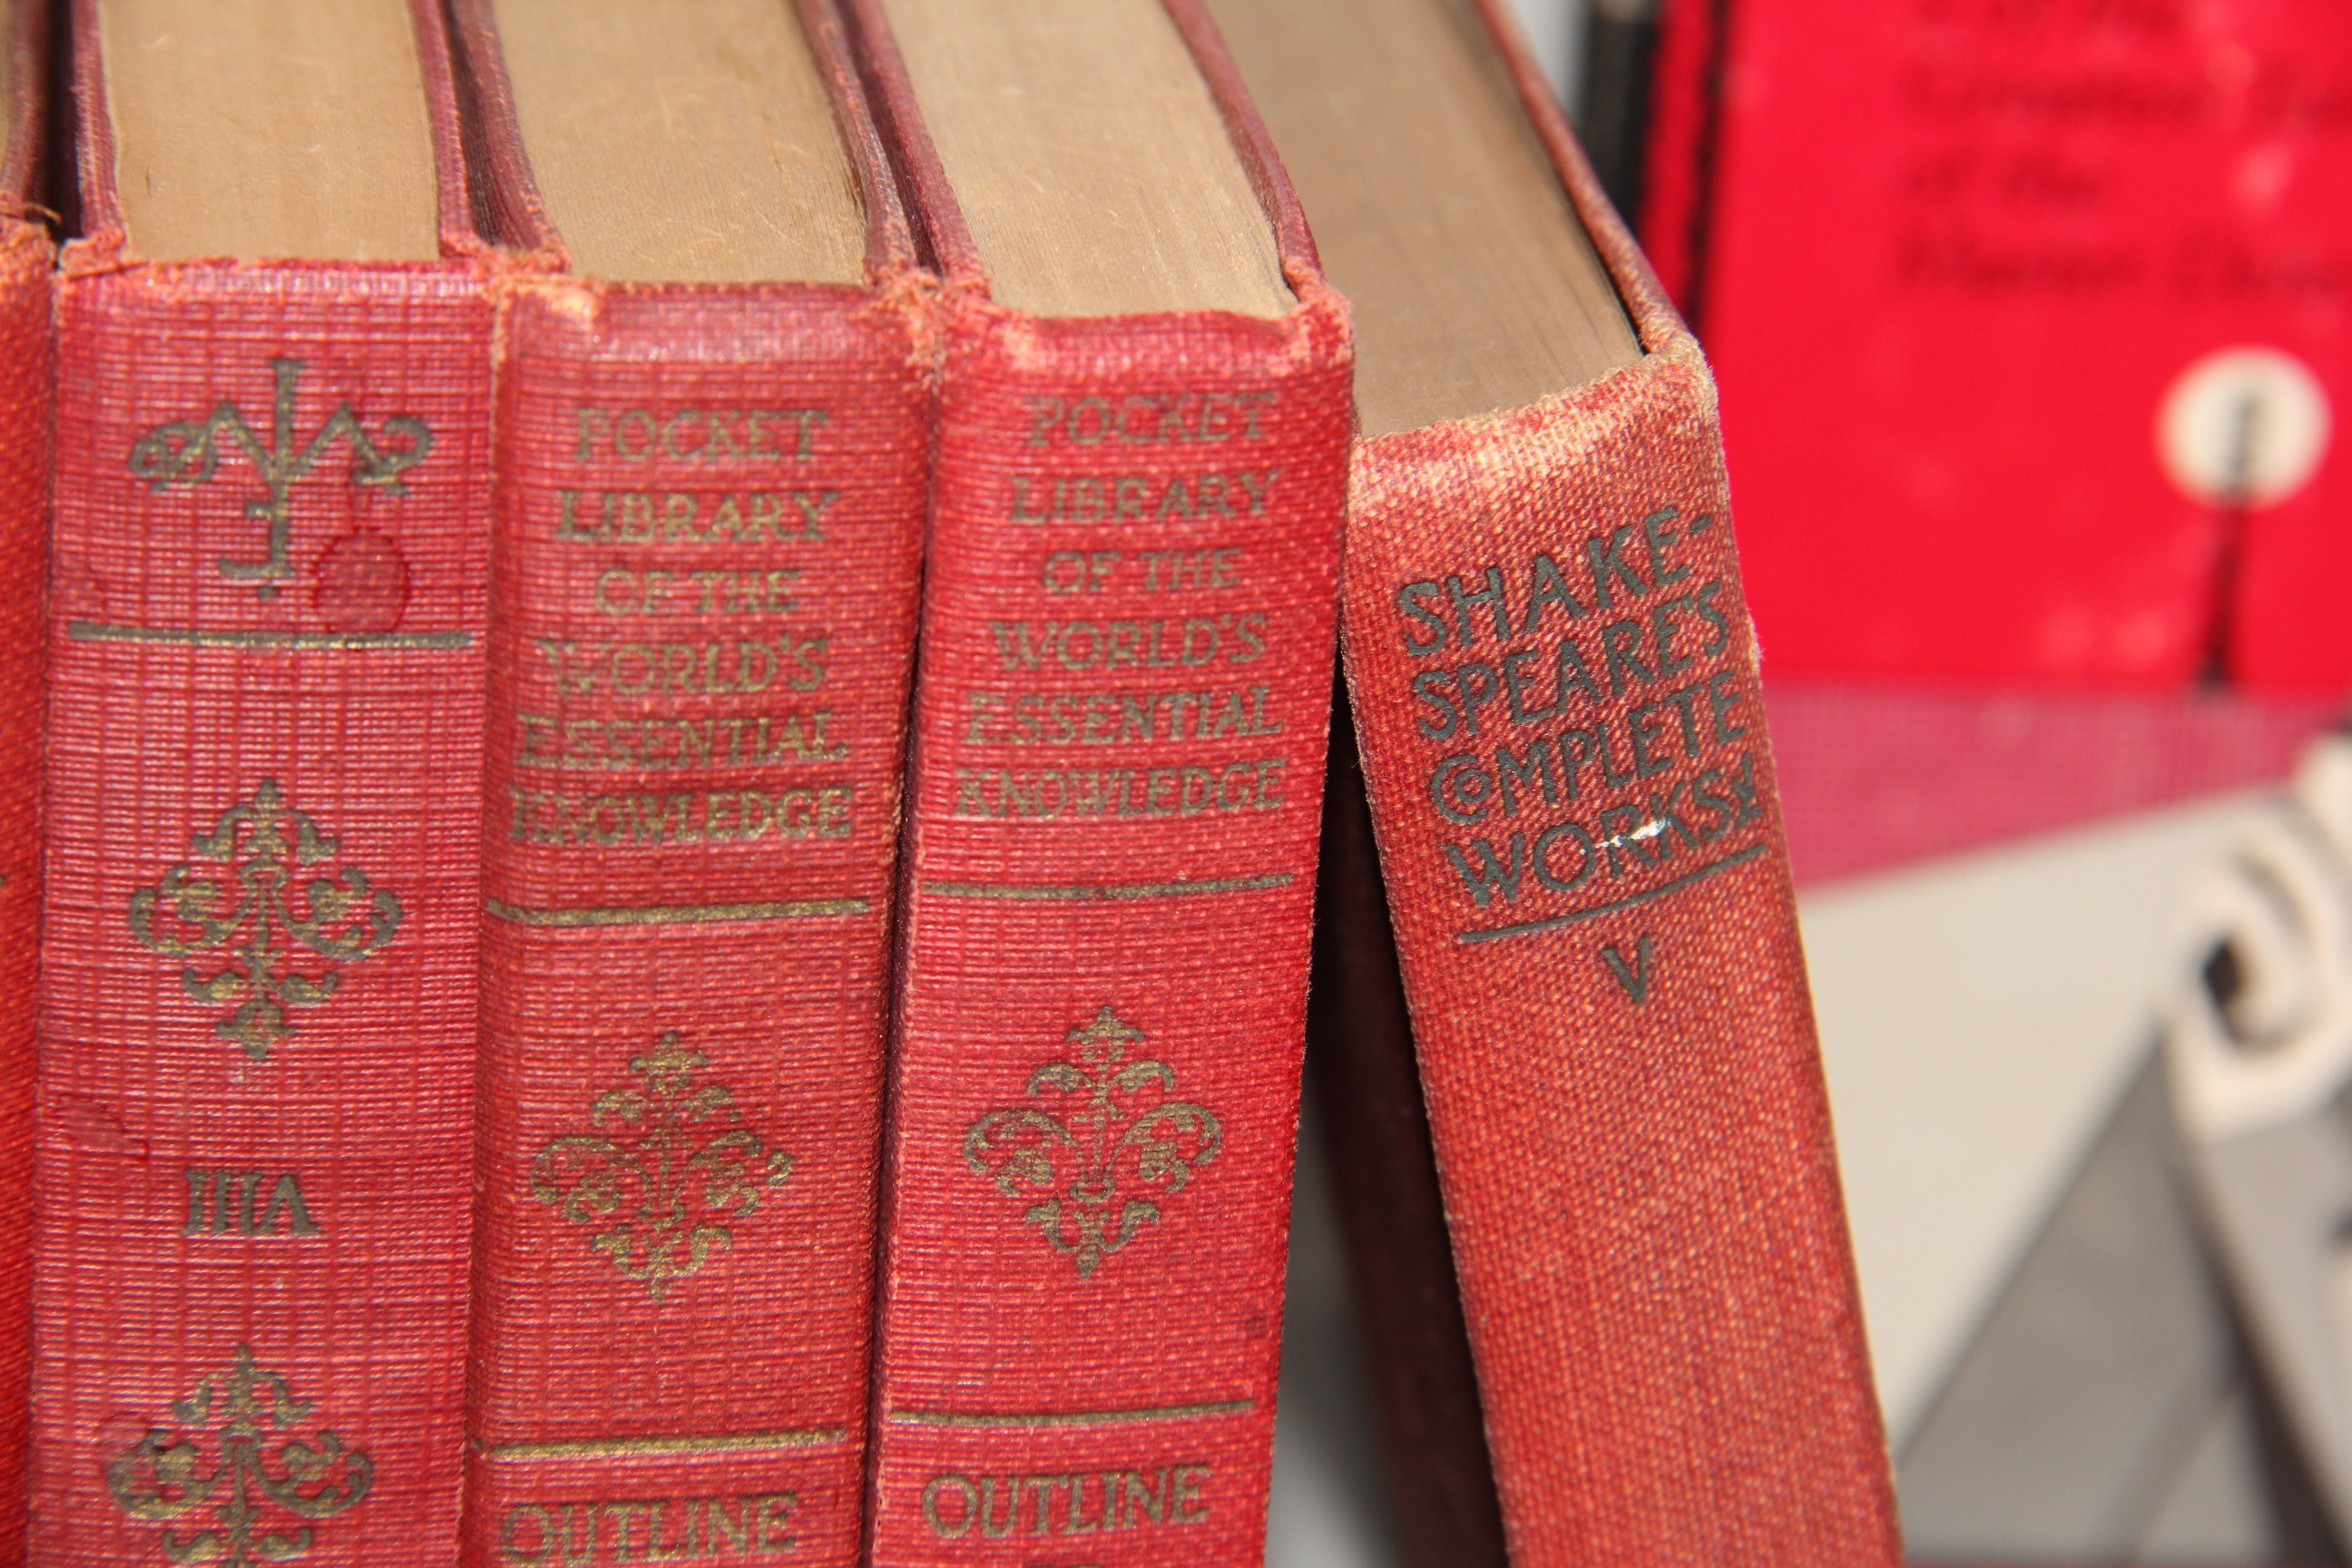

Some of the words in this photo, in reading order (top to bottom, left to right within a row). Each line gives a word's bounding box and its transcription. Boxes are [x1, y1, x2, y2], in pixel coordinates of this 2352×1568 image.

[575, 407, 828, 460] POCKET
[1025, 392, 1276, 446] POCKET
[554, 489, 839, 543] LIBRARY
[1009, 466, 1281, 524] LIBRARY
[594, 570, 673, 616] OF
[691, 570, 800, 614] THE
[1042, 550, 1120, 593] OF
[1140, 546, 1244, 592] THE
[1396, 505, 1711, 656] SHAKE-
[538, 636, 828, 695] WORLD'S
[986, 611, 1269, 671] WORLD'S
[1413, 580, 1729, 740] SPEARE'S
[516, 710, 850, 769] ESSENTIAL
[963, 685, 1283, 746] ESSENTIAL
[508, 784, 853, 846] KNOWLEDGE
[955, 759, 1287, 818] KNOWLEDGE
[1599, 935, 1651, 1004] V
[501, 1490, 798, 1568] OUTLINE
[922, 1464, 1211, 1540] OUTLINE
